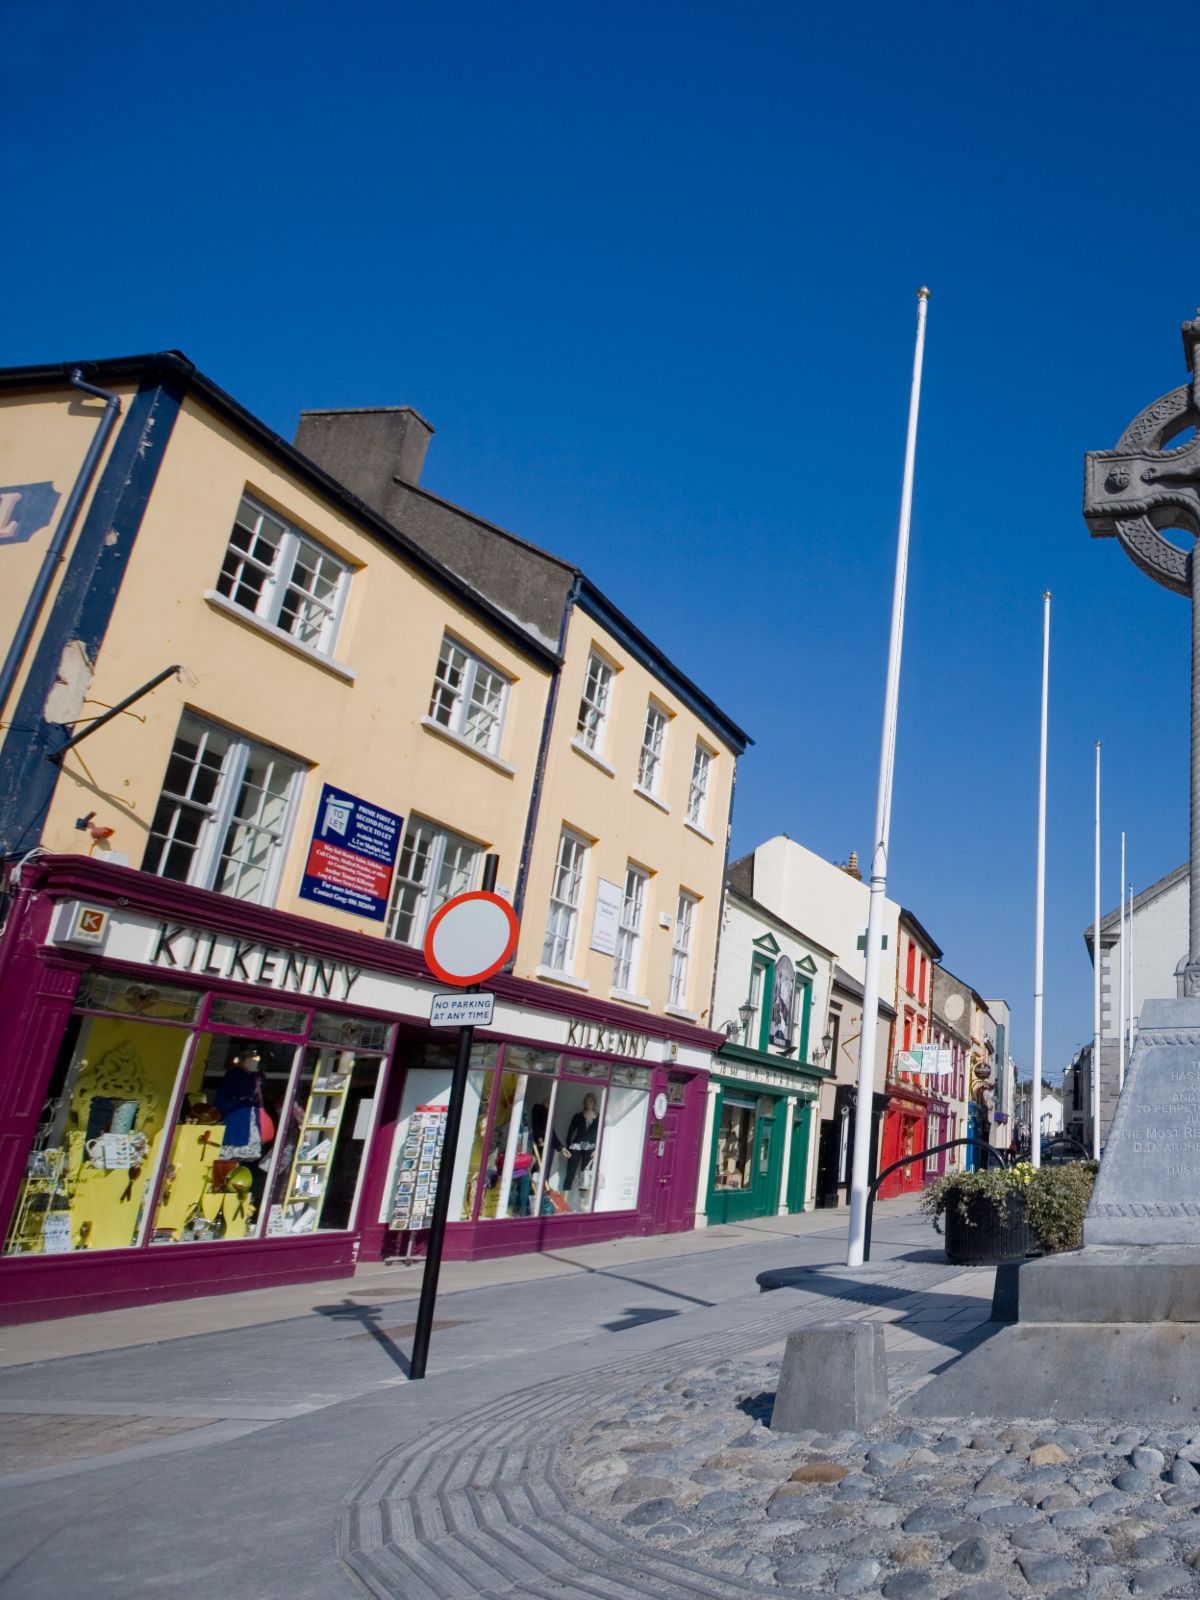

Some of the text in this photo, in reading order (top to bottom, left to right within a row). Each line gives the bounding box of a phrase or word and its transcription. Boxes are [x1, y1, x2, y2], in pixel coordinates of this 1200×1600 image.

[333, 808, 344, 819] TO
[329, 817, 344, 830] LET
[356, 813, 395, 833] SECOND FLOOR
[356, 822, 372, 832] SPACE
[313, 887, 333, 897] Contact
[345, 889, 372, 901] information
[83, 913, 101, 930] K
[150, 922, 361, 1000] KILKENNY
[451, 1000, 490, 1008] PARKING
[566, 1018, 650, 1059] KILKENNY
[1171, 1072, 1194, 1080] HAS
[1172, 1093, 1198, 1102] AND
[1136, 1104, 1151, 1113] TO
[1122, 1130, 1142, 1140] THE
[1167, 1163, 1192, 1175] THIS
